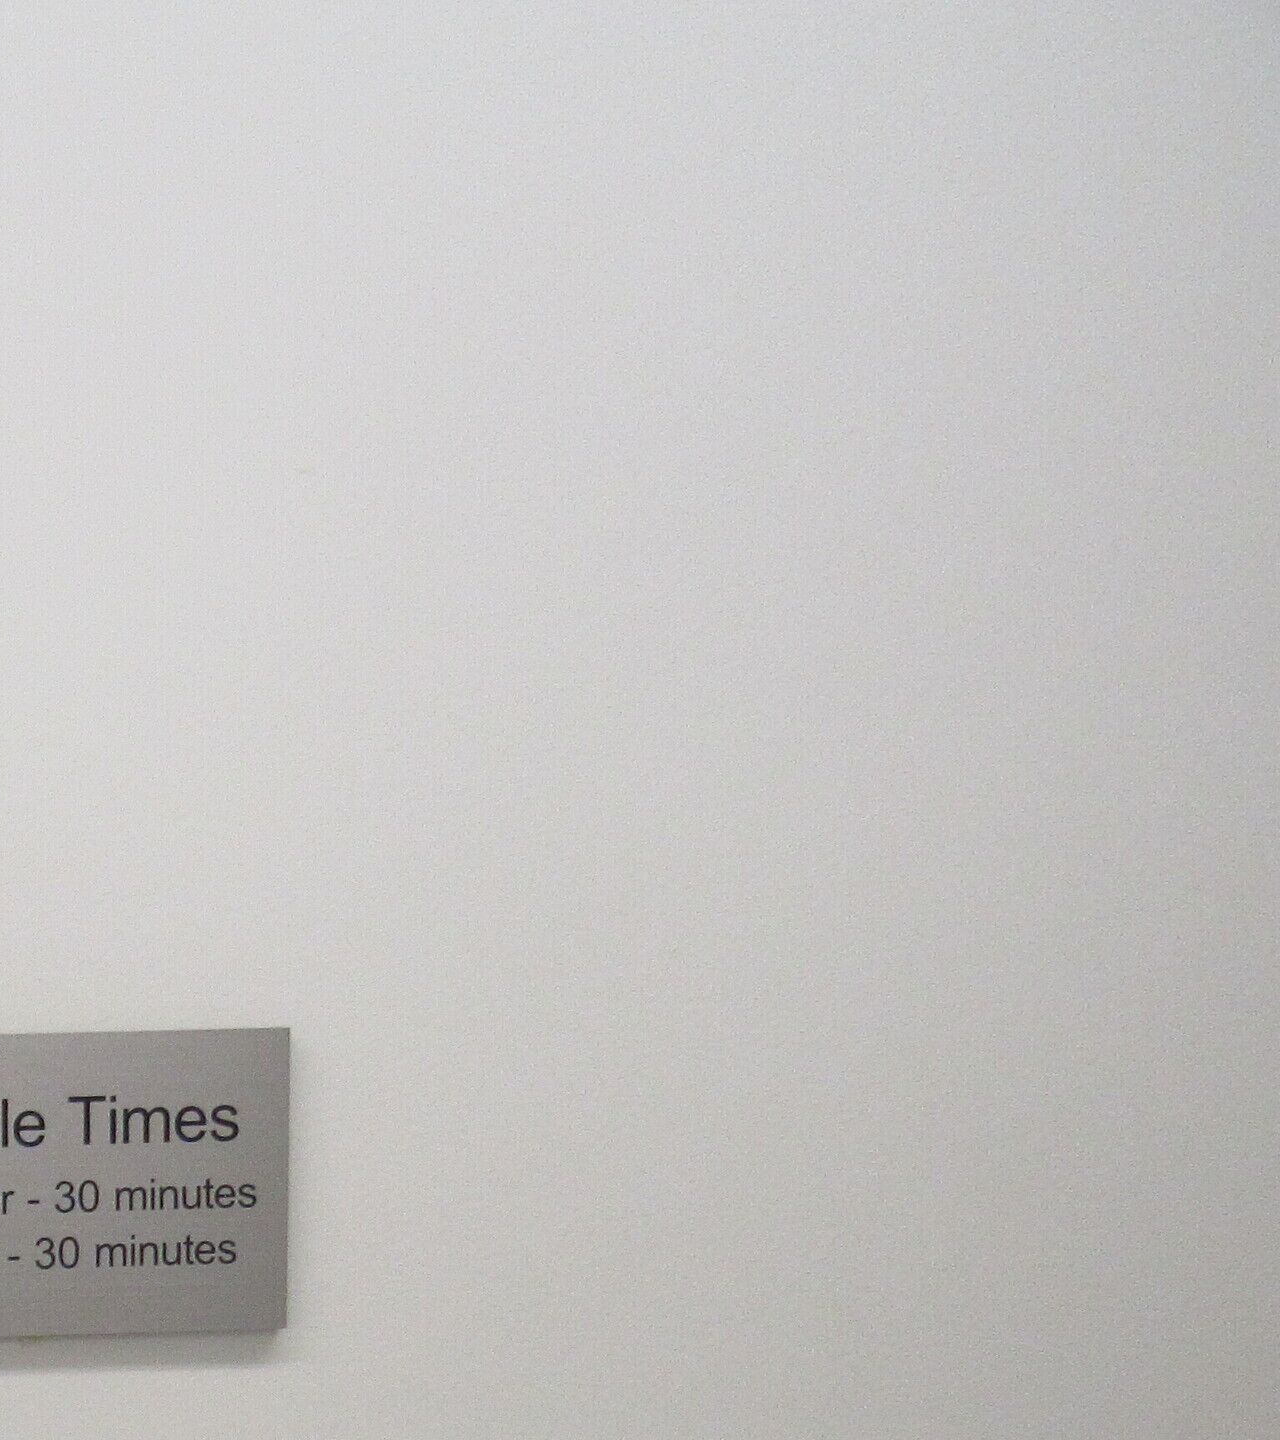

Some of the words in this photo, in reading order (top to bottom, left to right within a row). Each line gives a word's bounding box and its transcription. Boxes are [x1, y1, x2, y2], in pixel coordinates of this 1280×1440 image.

[69, 1095, 240, 1147] Times
[55, 1180, 100, 1214] 30
[115, 1179, 257, 1212] minutes
[35, 1237, 79, 1270] 30
[96, 1235, 236, 1268] minutes
